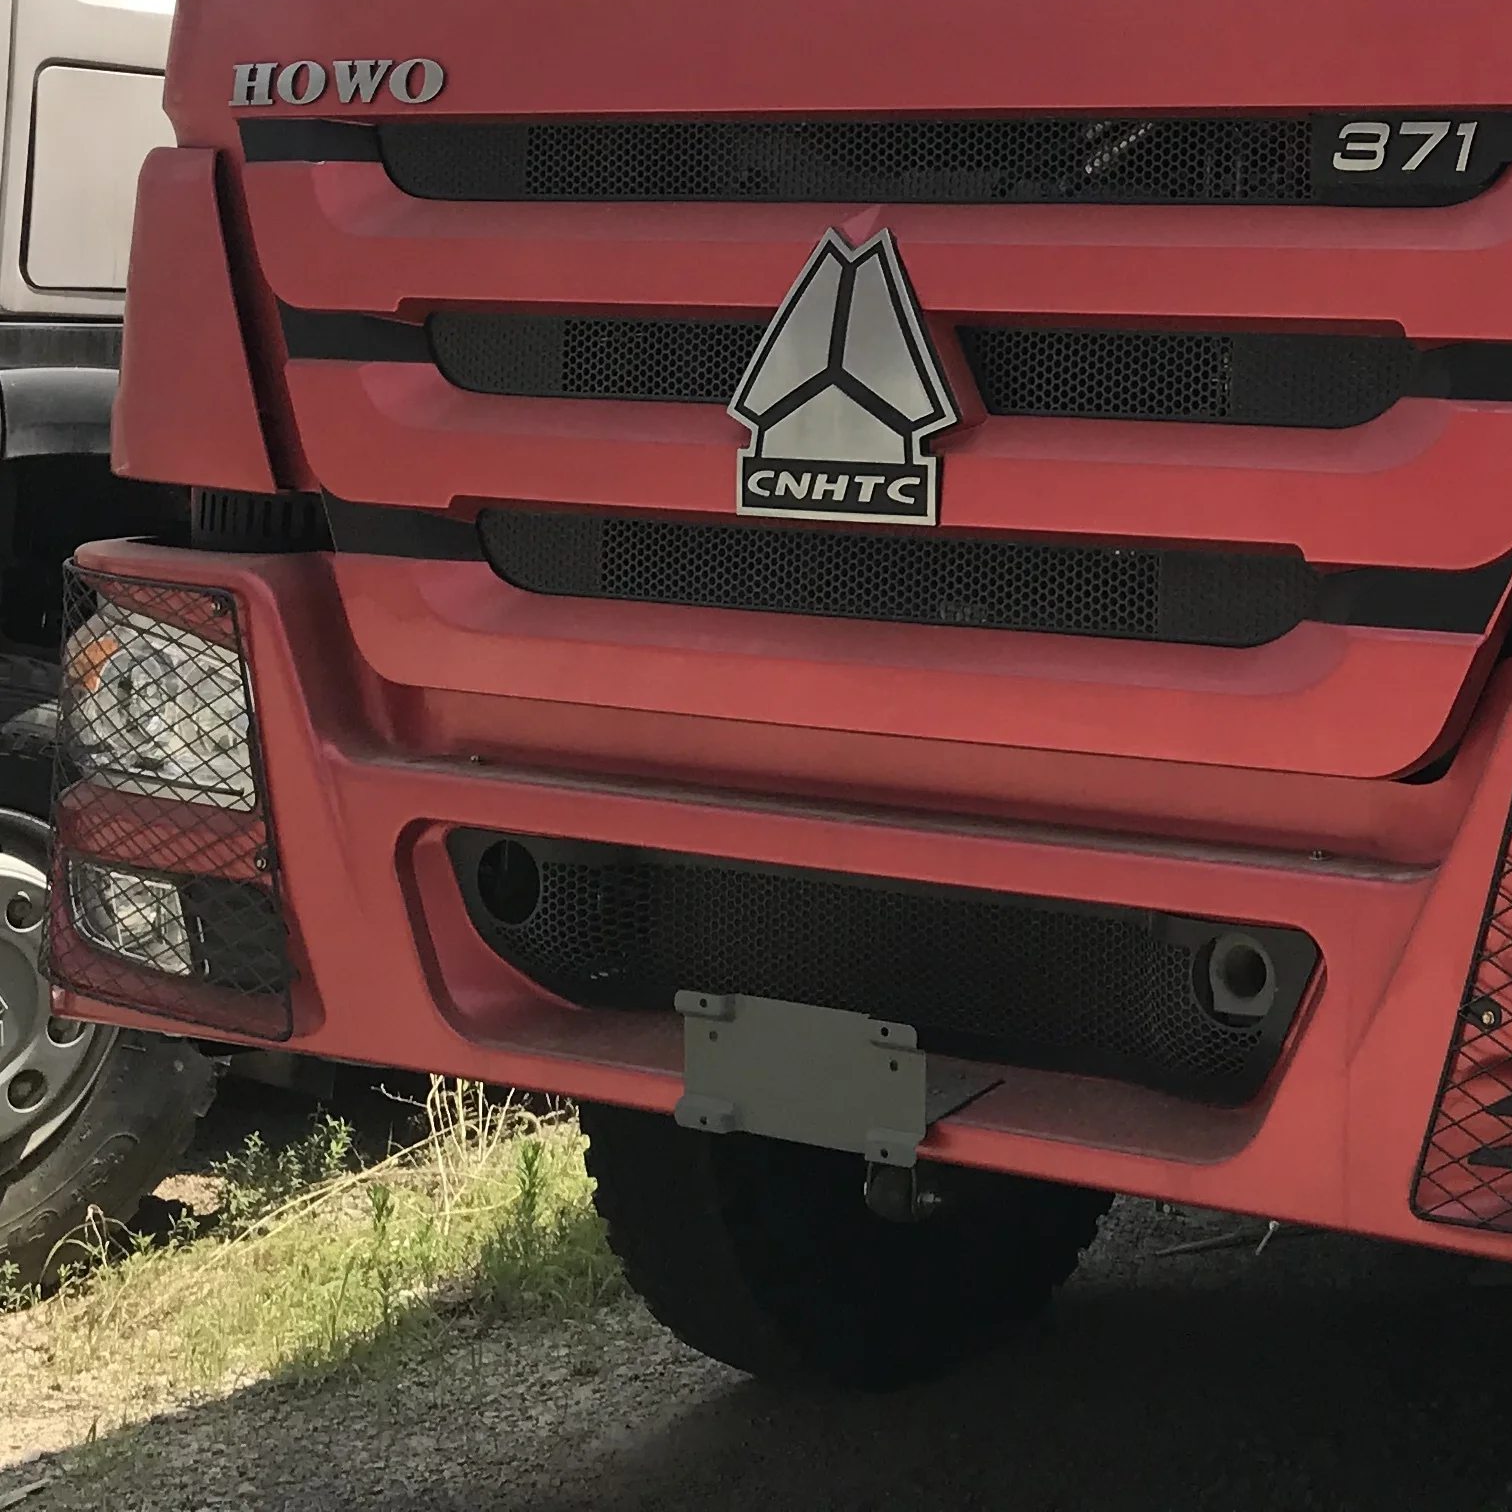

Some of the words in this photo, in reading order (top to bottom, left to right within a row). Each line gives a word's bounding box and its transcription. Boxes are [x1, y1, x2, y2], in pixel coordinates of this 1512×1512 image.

[228, 58, 444, 106] HOWO
[1332, 121, 1478, 172] 371
[747, 470, 921, 505] CNHTC
